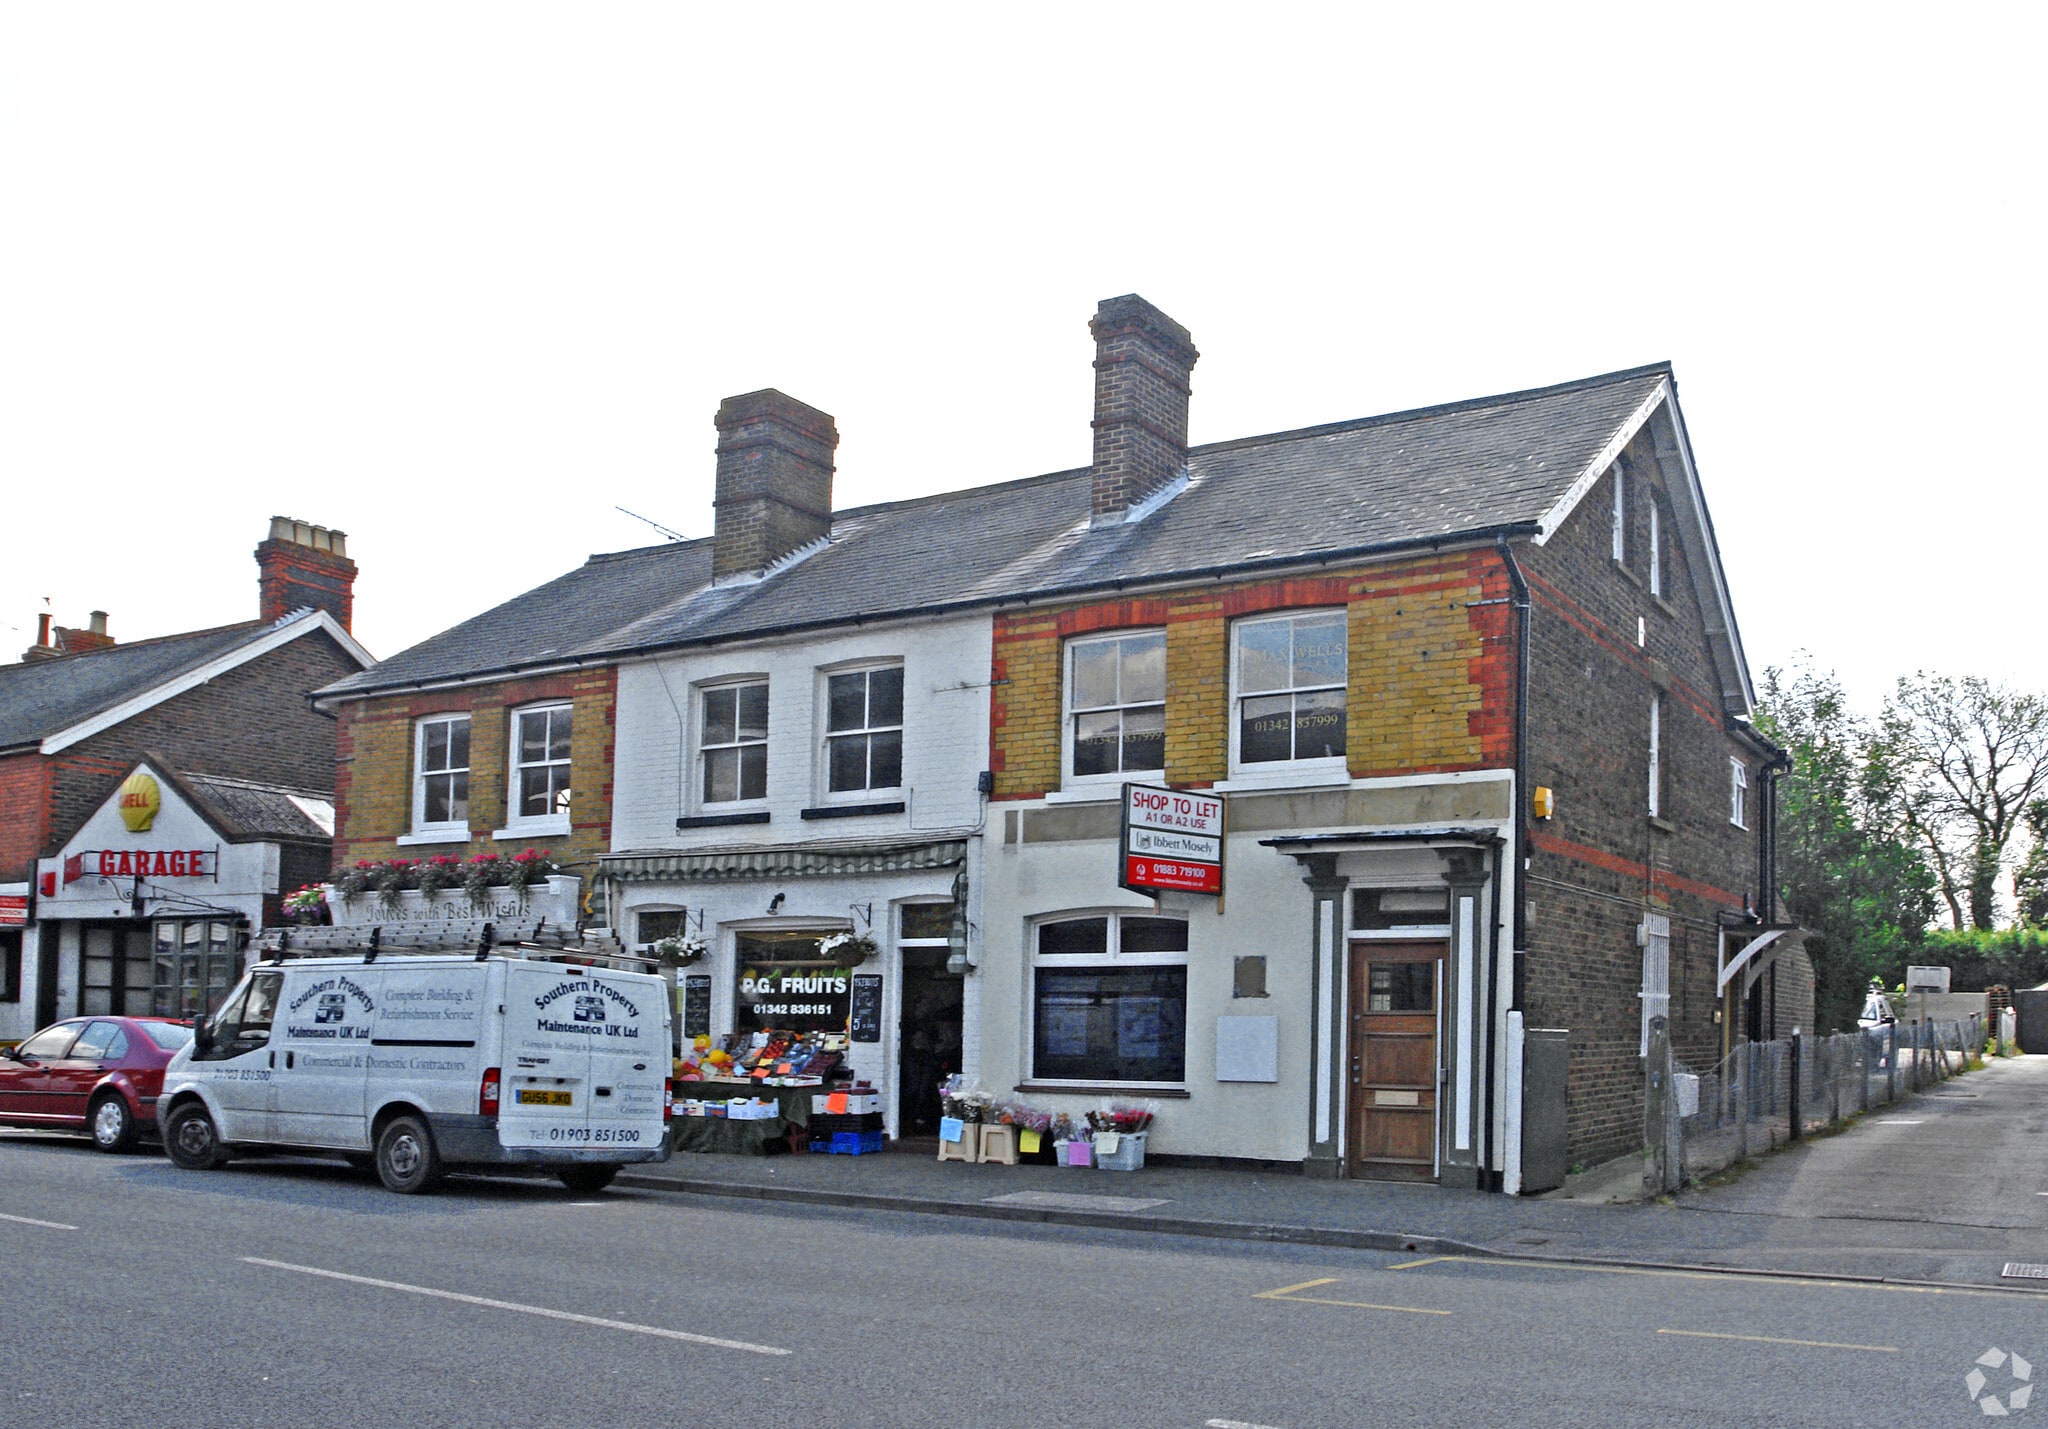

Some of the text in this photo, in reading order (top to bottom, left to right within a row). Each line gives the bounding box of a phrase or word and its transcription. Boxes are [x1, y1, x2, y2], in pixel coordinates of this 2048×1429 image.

[1254, 714, 1338, 732] 01342 837999
[1133, 791, 1219, 819] SHOP TO LET
[1145, 812, 1207, 829] A1 OR A2 USE
[1153, 835, 1214, 856] Ibbett Mosely
[99, 849, 204, 878] GARAGE
[443, 902, 475, 920] Best
[476, 900, 531, 919] Wishes
[290, 975, 375, 1013] Southern Property
[742, 977, 776, 994] P.G.
[781, 977, 847, 994] FRUITS
[427, 988, 464, 1005] Building
[465, 988, 474, 1001] &
[534, 979, 640, 1018] Southern Property
[753, 1004, 832, 1015] 01342 836151
[286, 1026, 370, 1039] Maintenance UK Ltd
[537, 1018, 639, 1038] Maintenance UK Ltd
[302, 1054, 466, 1071] Commercial & Domestic Contractors
[517, 1056, 551, 1064] TRANSIT
[521, 1091, 549, 1103] GU56
[550, 1128, 591, 1142] 01903
[594, 1129, 640, 1143] 851500
